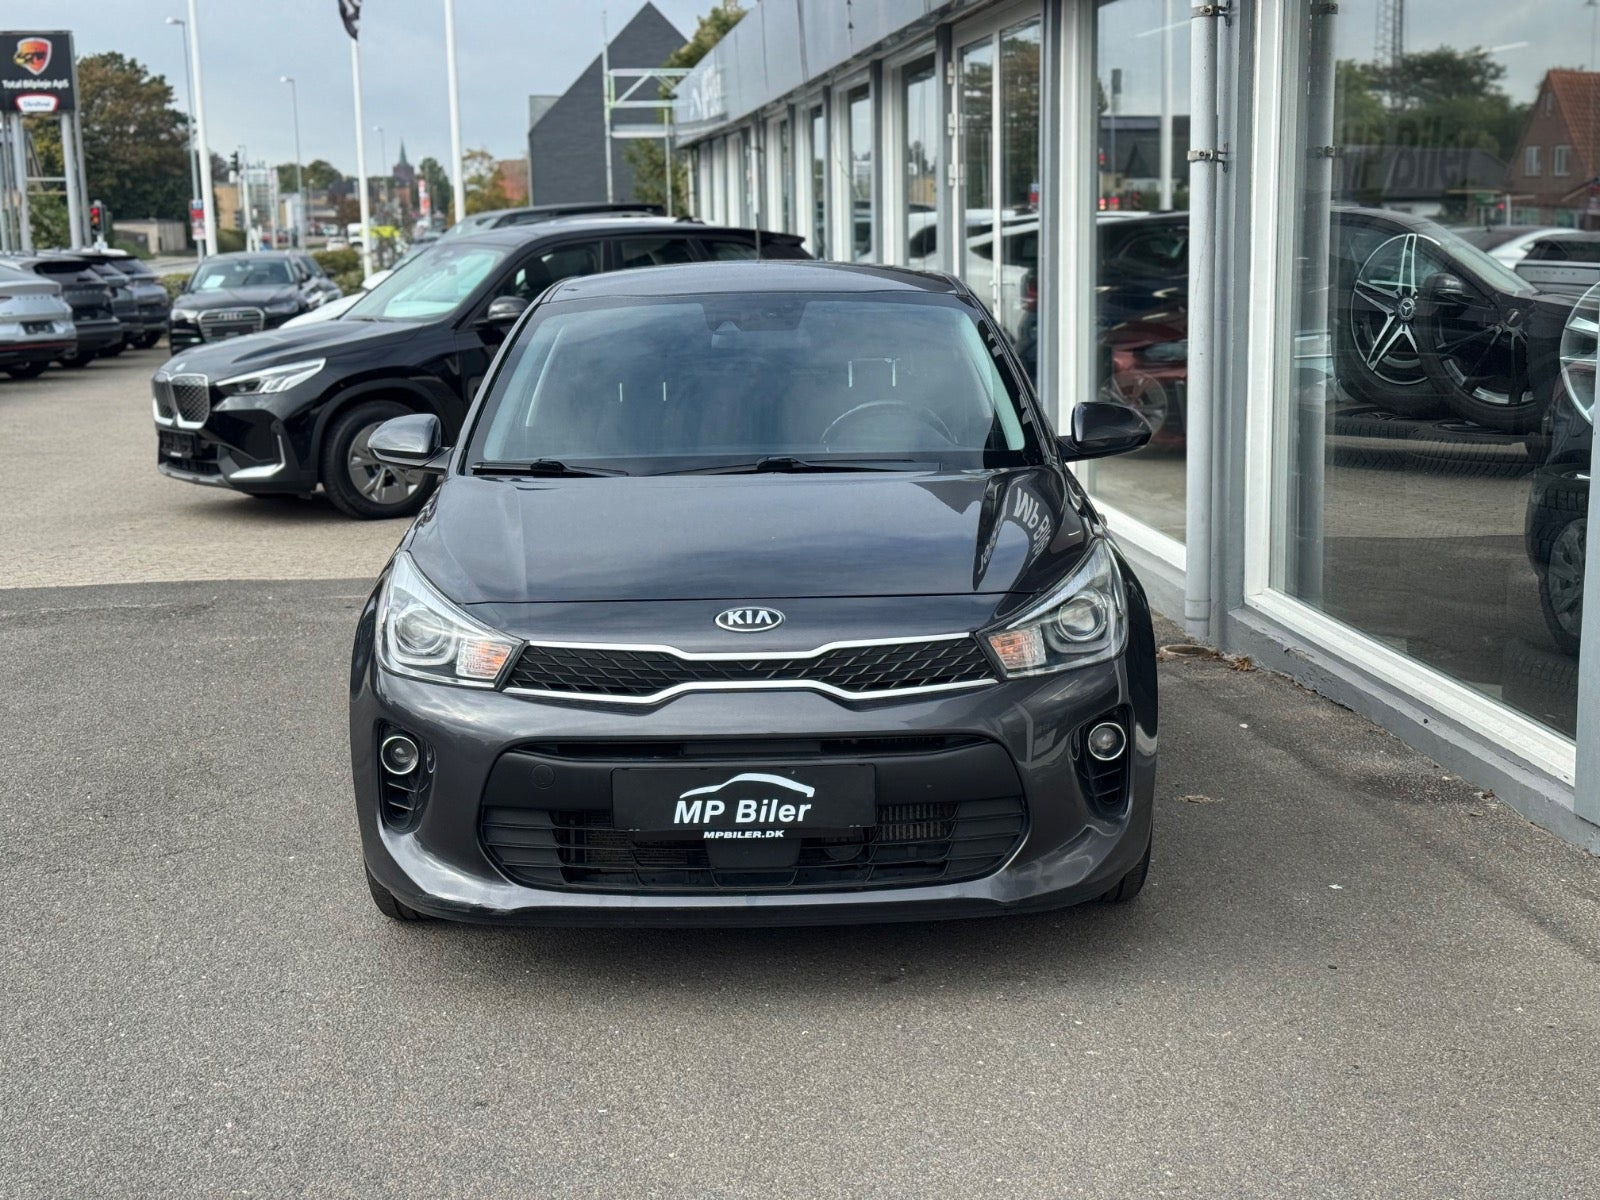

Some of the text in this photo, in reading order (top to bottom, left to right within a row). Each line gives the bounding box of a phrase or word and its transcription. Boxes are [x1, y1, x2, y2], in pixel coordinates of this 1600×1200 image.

[727, 609, 773, 626] KIA
[673, 798, 812, 824] MP Biler
[703, 829, 785, 839] MPBILER.DK
